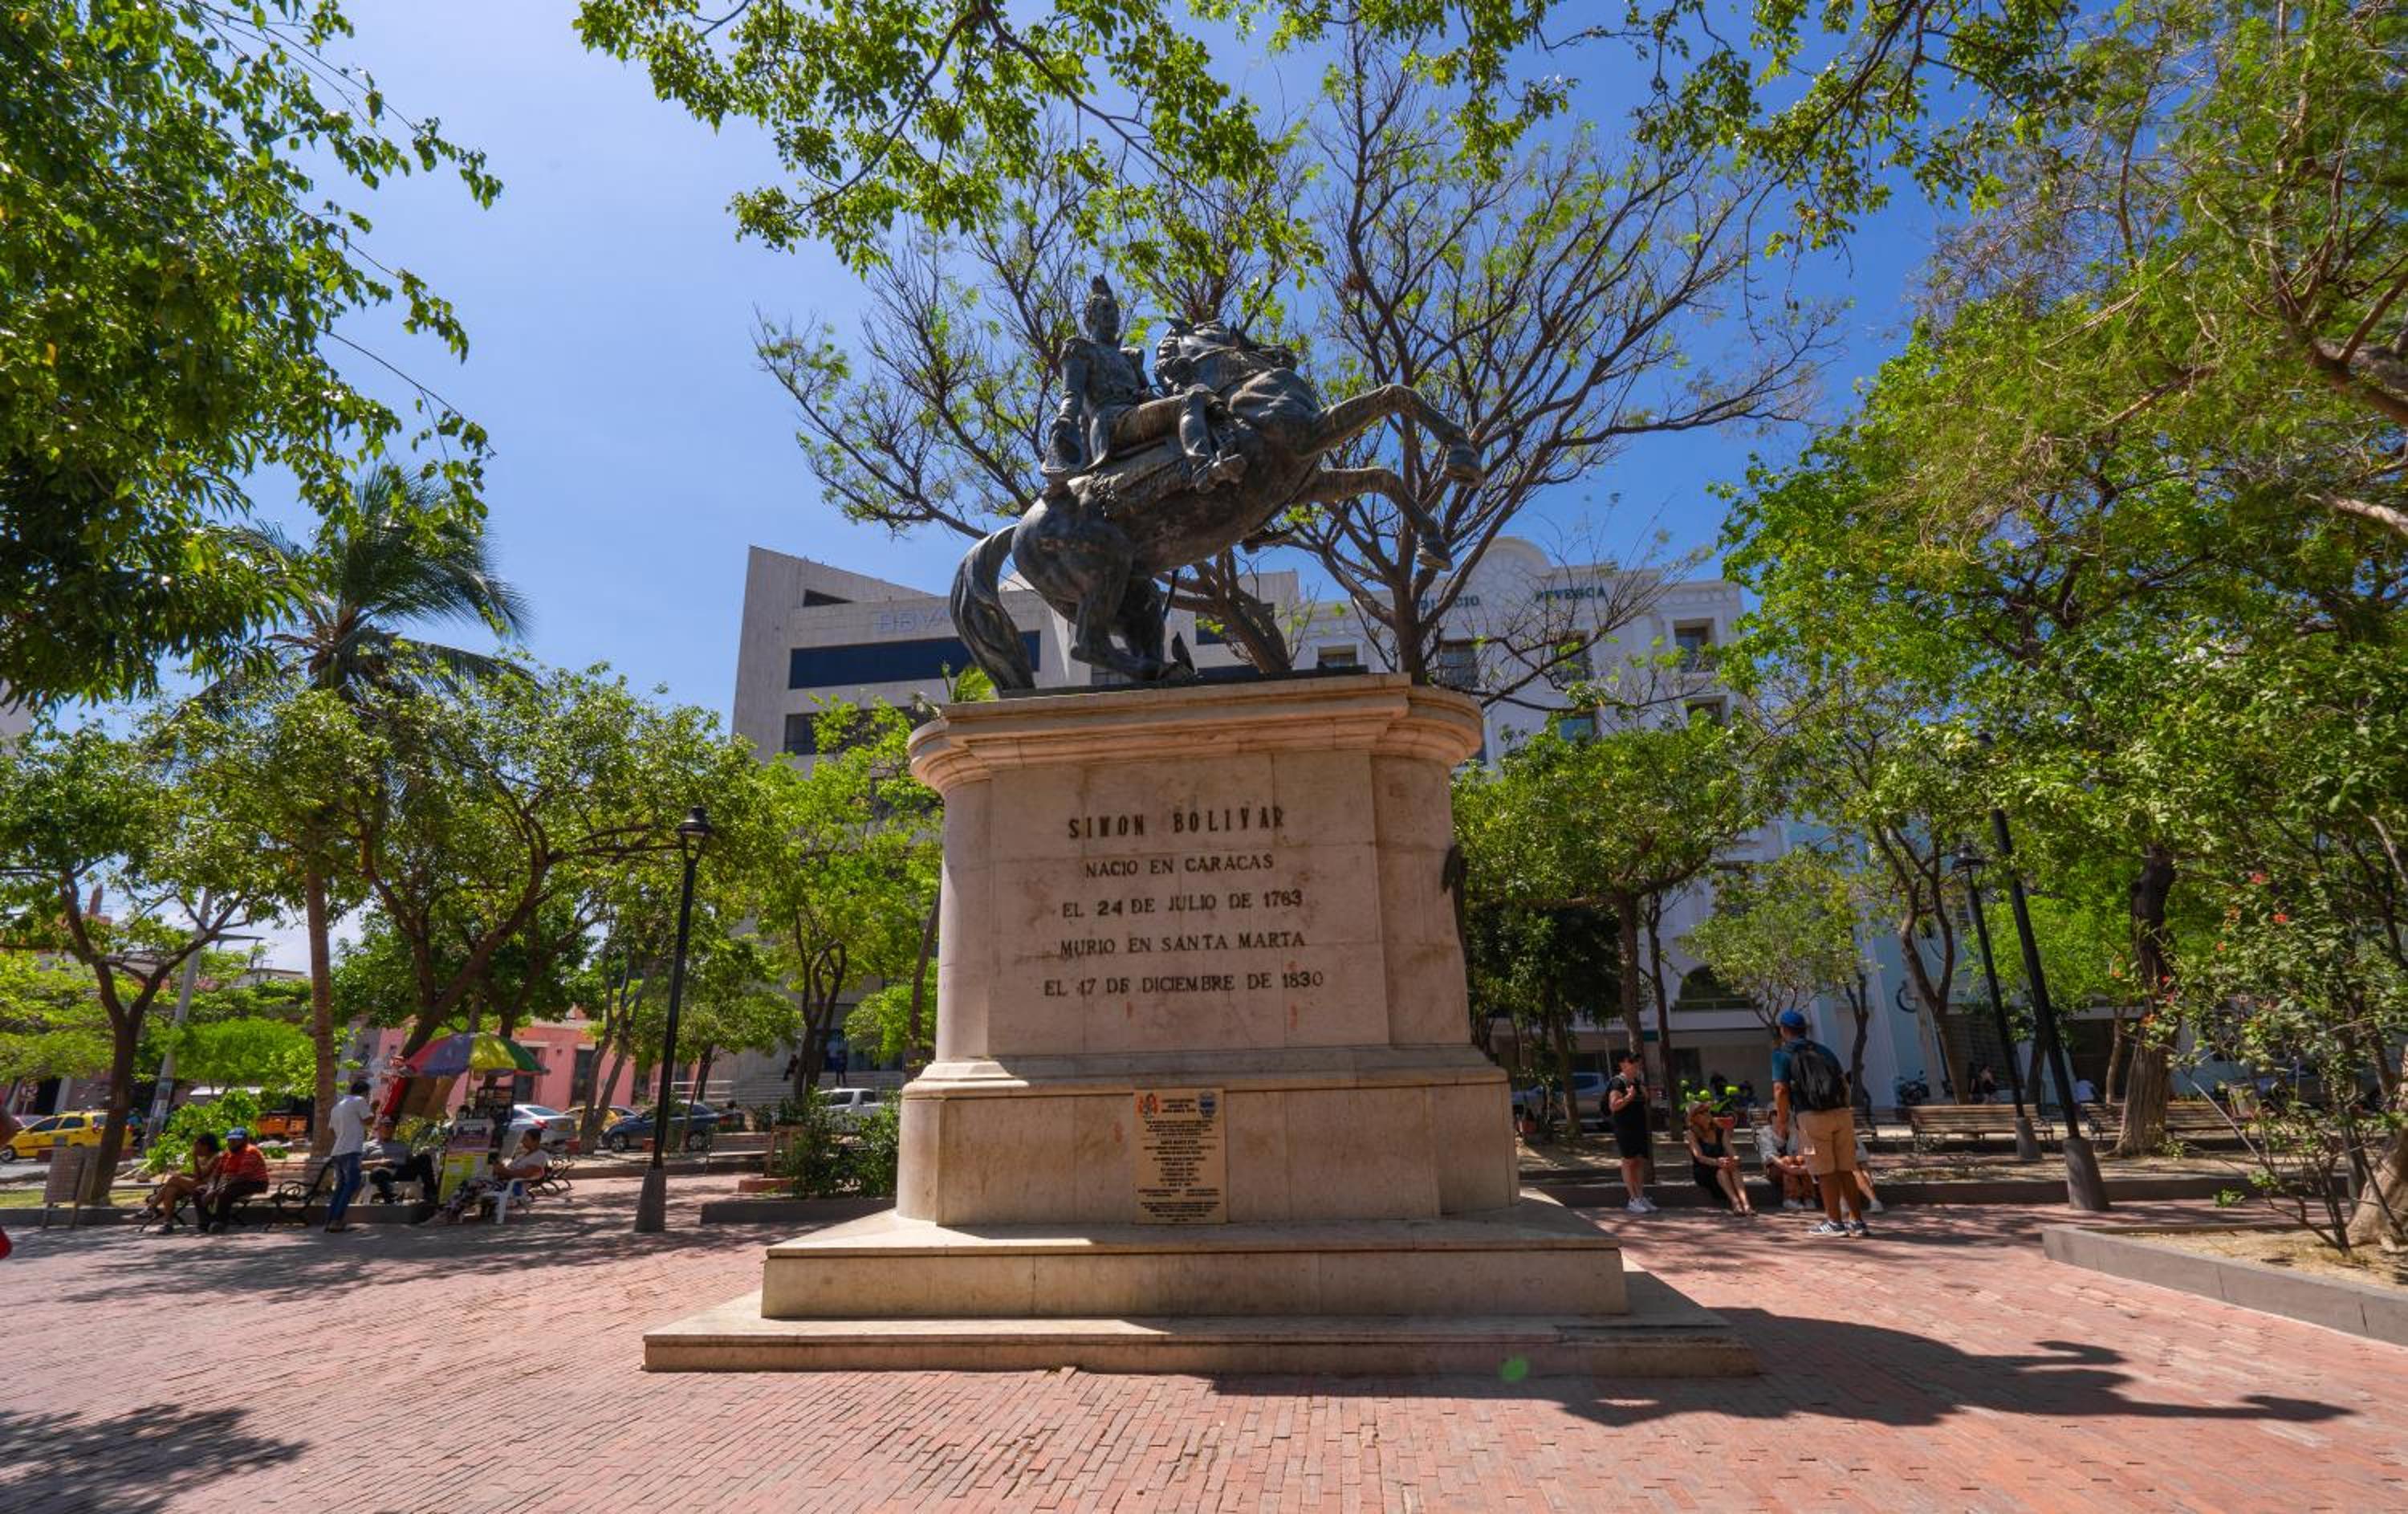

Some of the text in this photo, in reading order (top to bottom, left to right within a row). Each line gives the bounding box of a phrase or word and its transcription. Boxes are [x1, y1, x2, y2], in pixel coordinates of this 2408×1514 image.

[1068, 805, 1284, 840] SIMON BOLIVAR
[1085, 853, 1274, 879] NACIO EN CARACAS
[1062, 901, 1085, 919] EL
[1096, 899, 1123, 917] 24
[1130, 897, 1156, 914] DE
[1168, 893, 1218, 914] JULIO
[1228, 892, 1253, 910] DE
[1059, 931, 1307, 959] MURIO EN SANTA MARTA
[1043, 971, 1324, 999] EL 17 DE DICIEMBRE DE 1830
